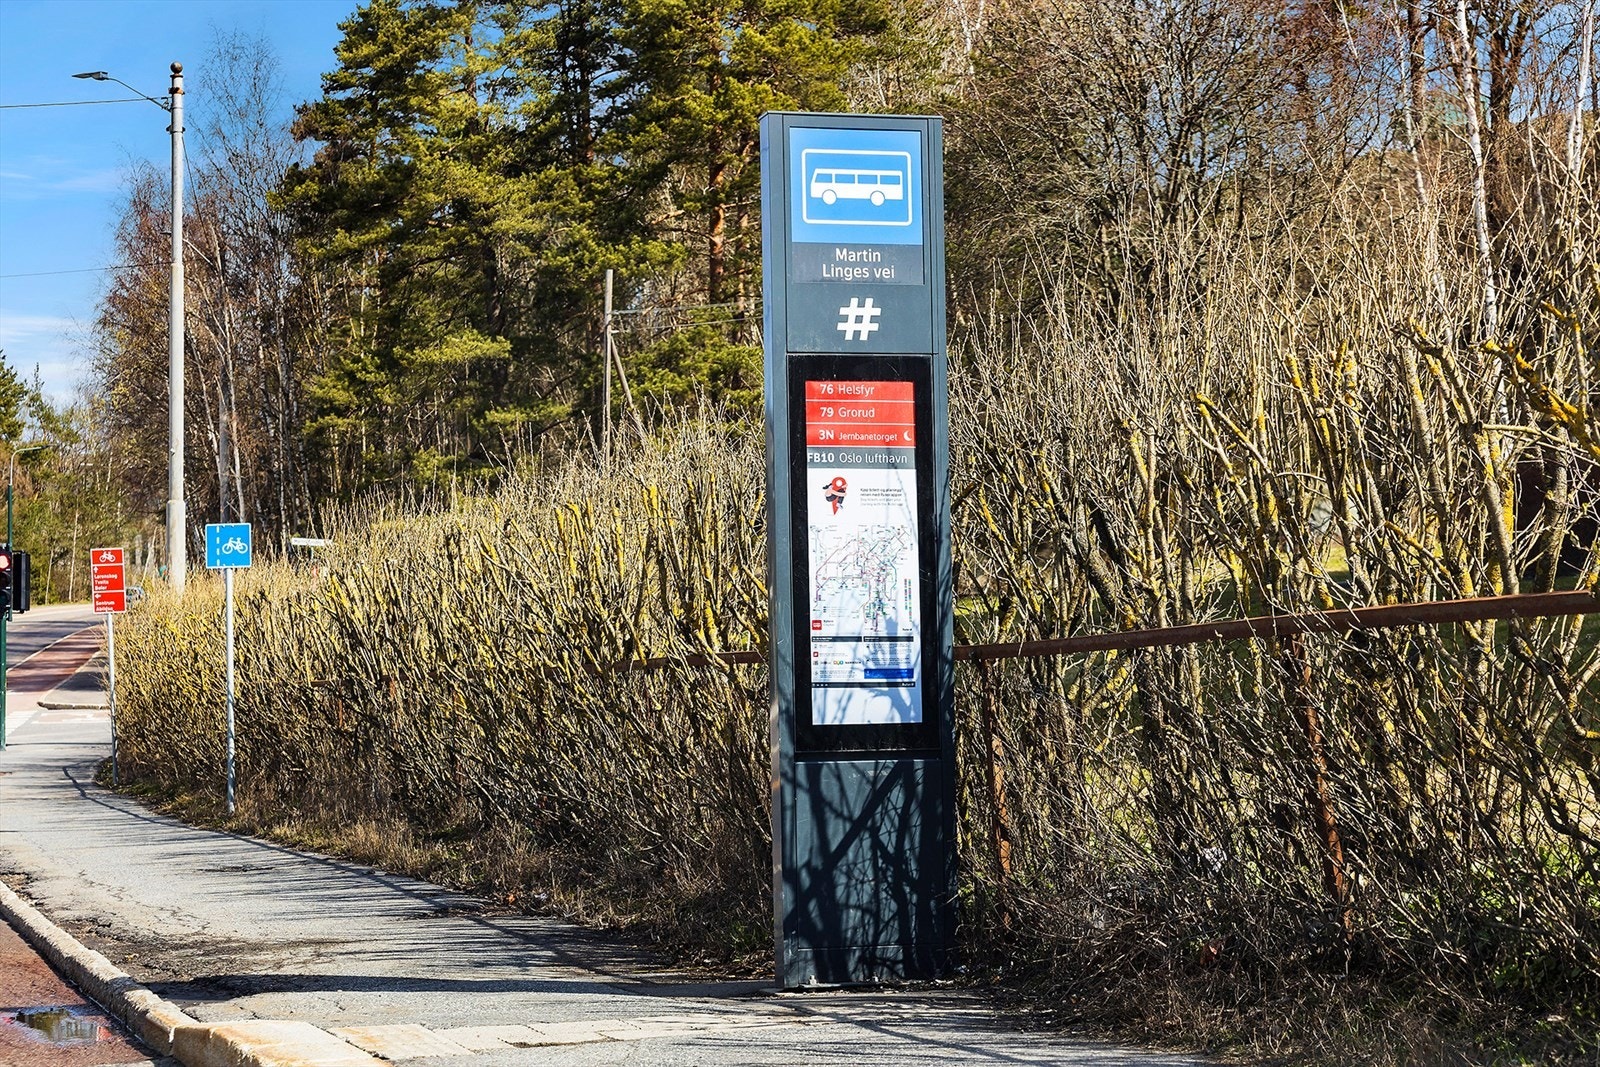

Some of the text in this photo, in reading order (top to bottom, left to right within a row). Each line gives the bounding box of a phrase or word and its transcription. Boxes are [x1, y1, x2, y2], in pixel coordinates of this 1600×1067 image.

[835, 247, 881, 262] Martin
[822, 263, 895, 281] Linges vei
[820, 384, 875, 397] 76 Helsfyr
[820, 407, 875, 418] 79 Grorud
[819, 429, 898, 443] 3N Jernbanetorget
[807, 452, 908, 464] FB10 Oslo lufthavn
